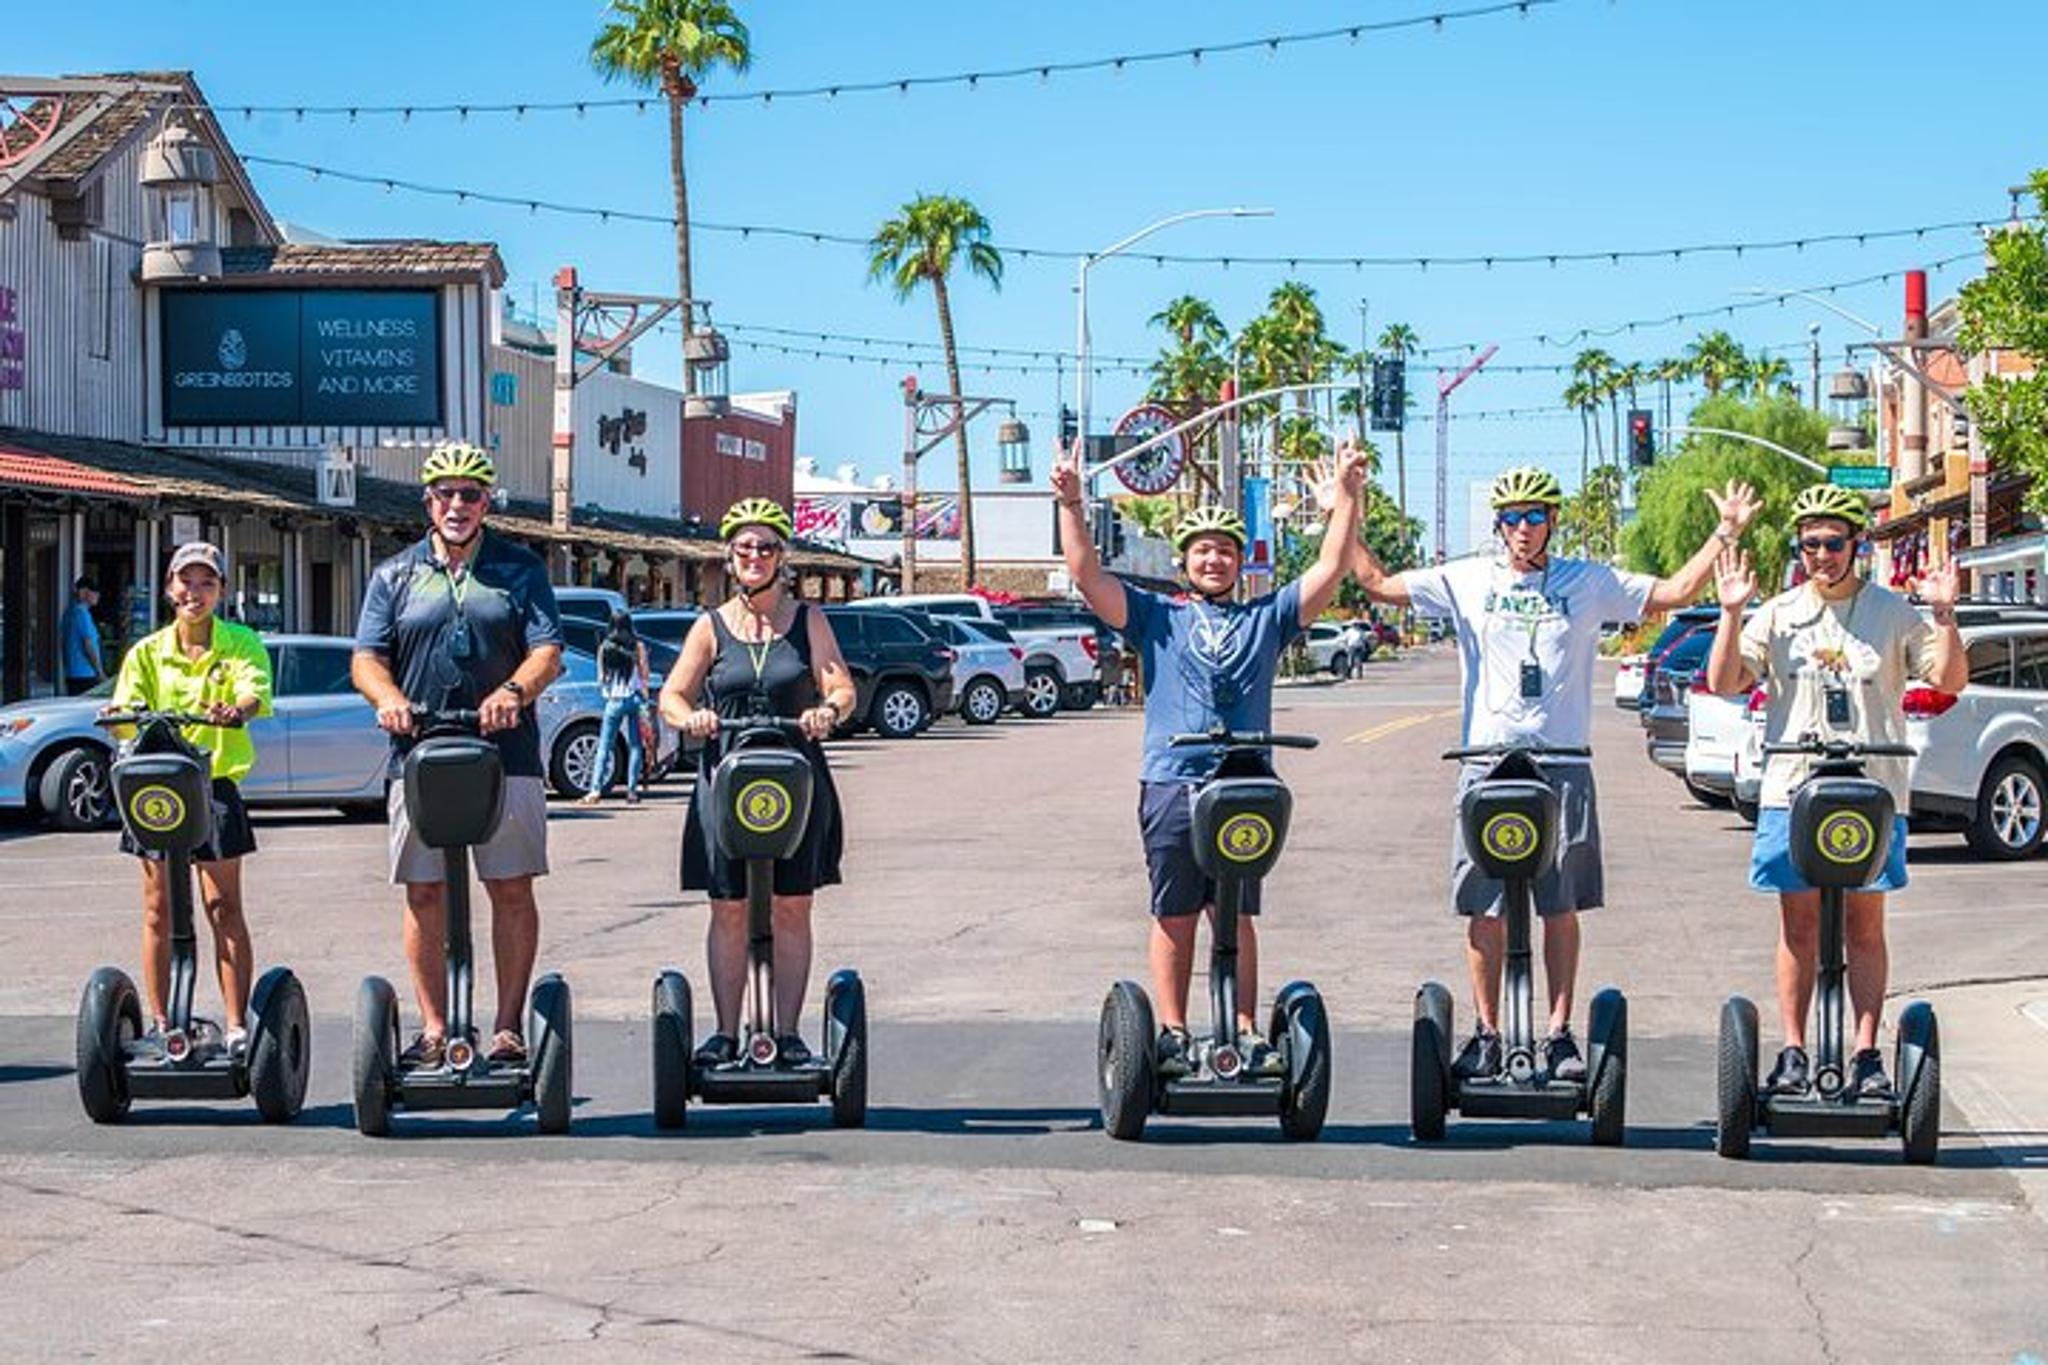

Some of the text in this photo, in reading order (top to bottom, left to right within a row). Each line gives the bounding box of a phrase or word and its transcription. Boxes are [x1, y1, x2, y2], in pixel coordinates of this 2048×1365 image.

[320, 349, 414, 367] VITAMINS
[317, 375, 419, 393] AND MORE
